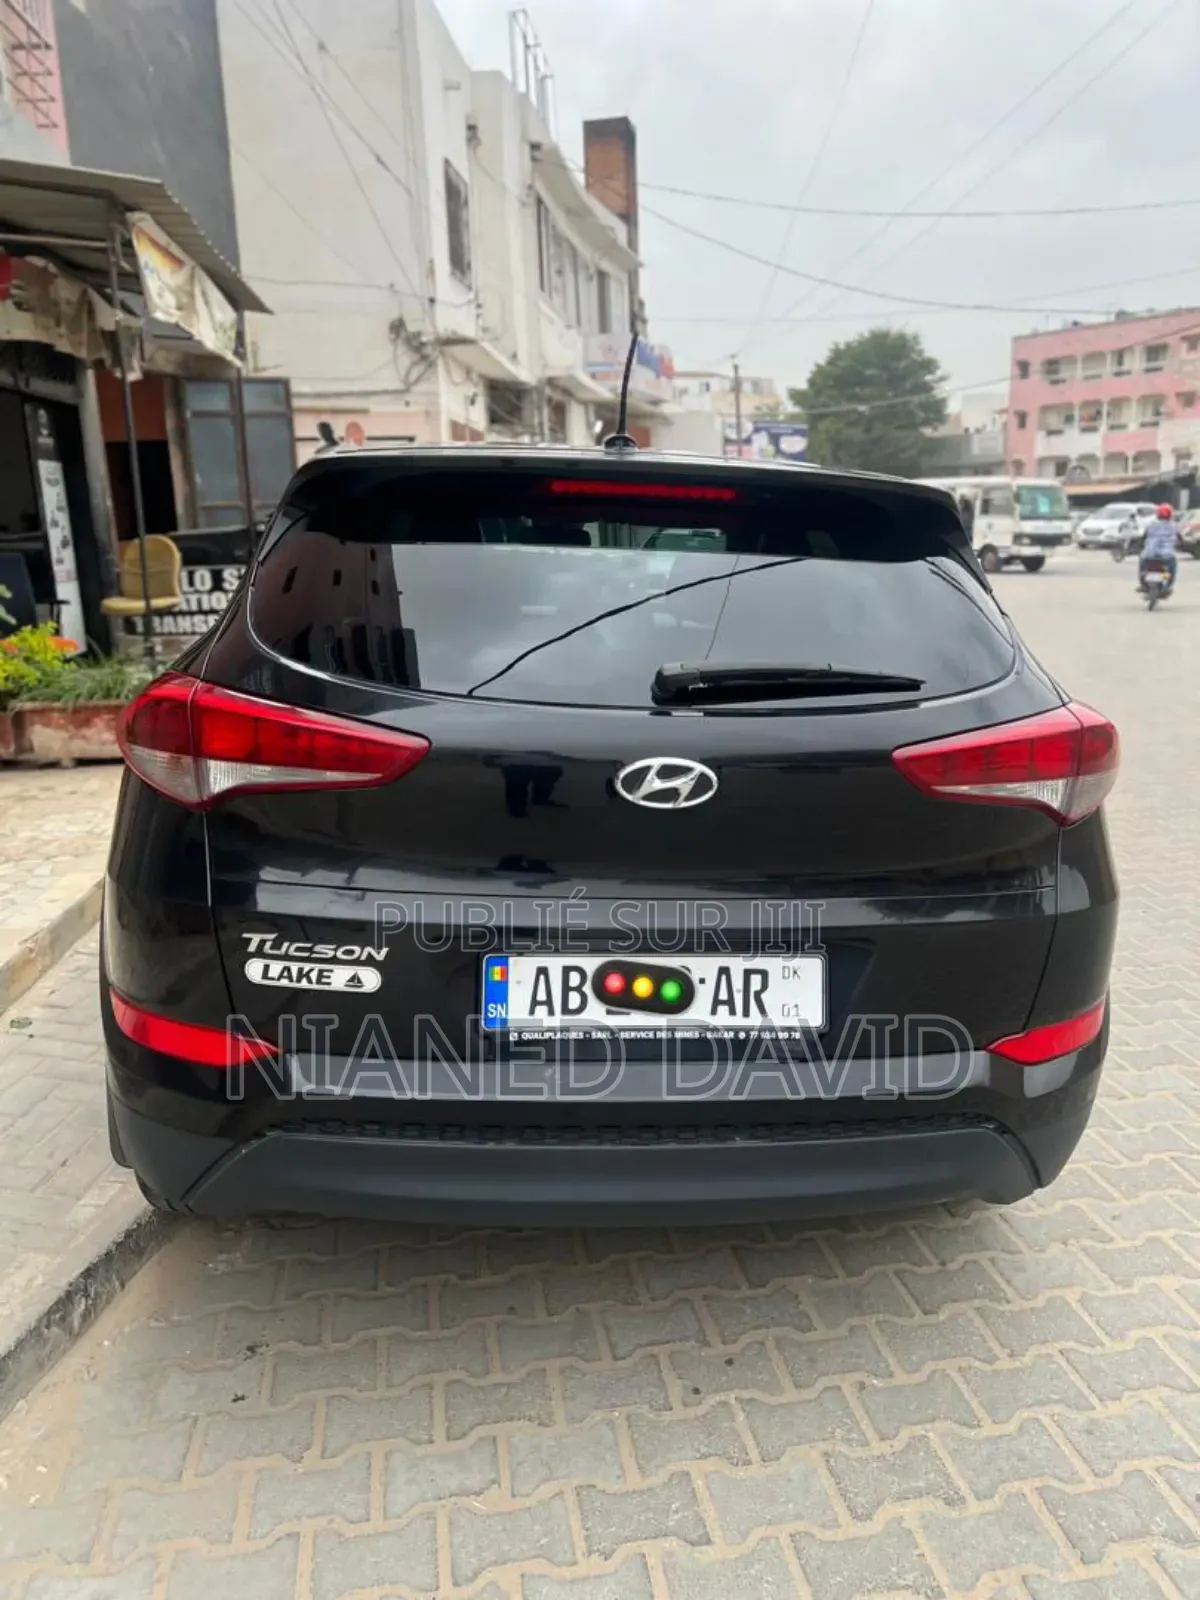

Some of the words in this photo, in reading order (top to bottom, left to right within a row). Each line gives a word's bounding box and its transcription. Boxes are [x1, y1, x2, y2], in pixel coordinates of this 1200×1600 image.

[180, 569, 212, 592] LO
[222, 567, 246, 592] S
[178, 592, 232, 612] ATIO
[261, 964, 334, 986] LAKE
[781, 965, 801, 980] DK
[488, 1003, 507, 1019] SN
